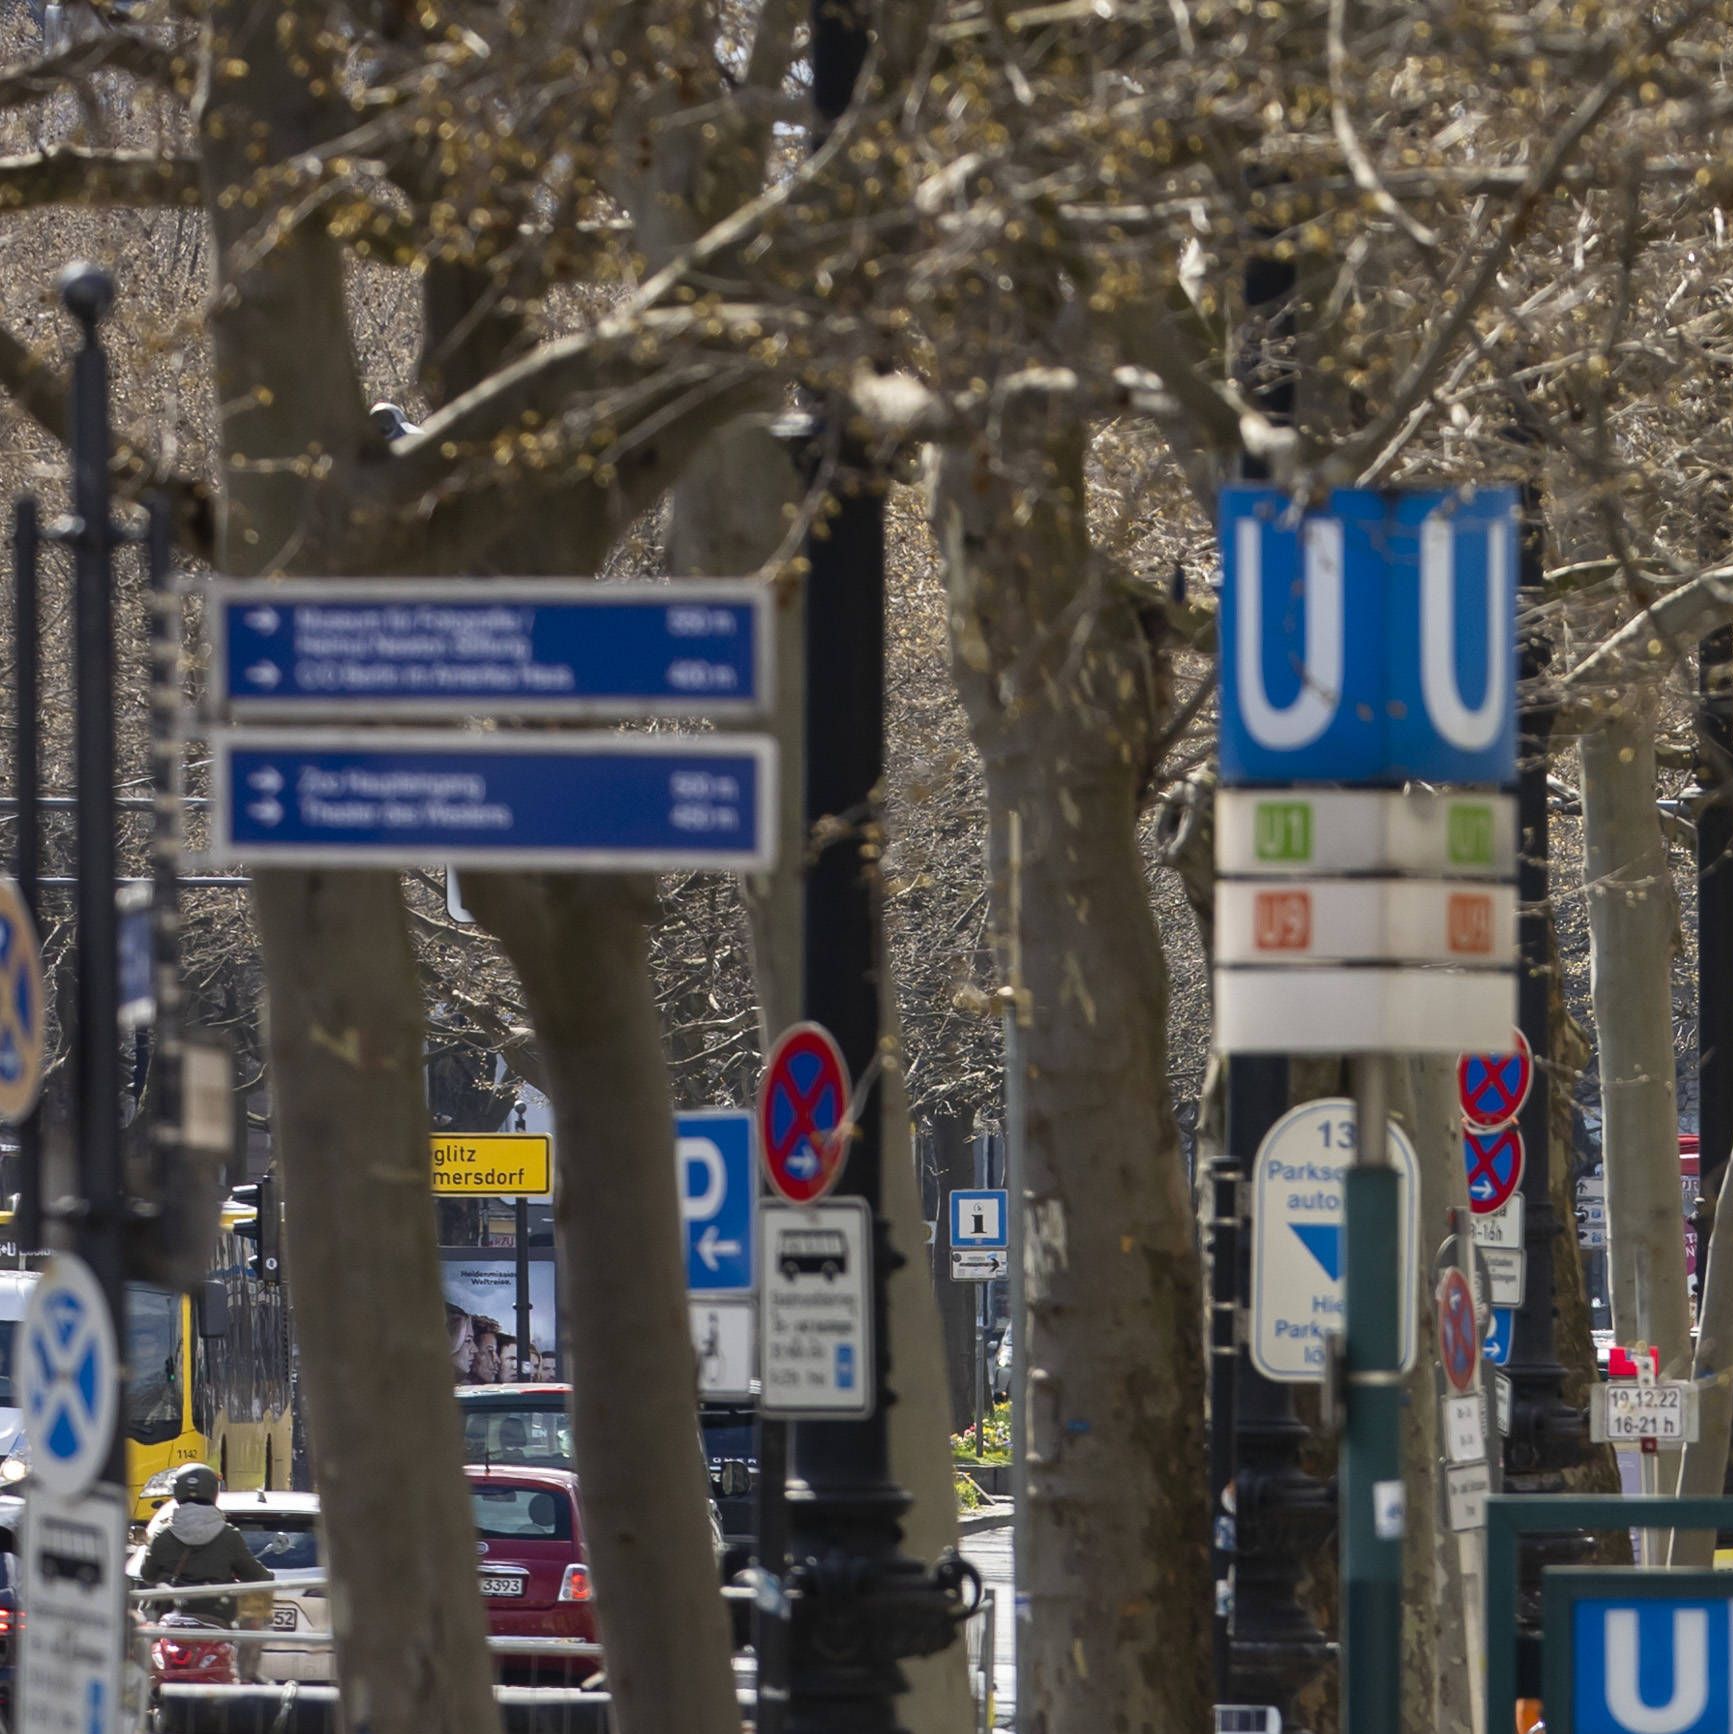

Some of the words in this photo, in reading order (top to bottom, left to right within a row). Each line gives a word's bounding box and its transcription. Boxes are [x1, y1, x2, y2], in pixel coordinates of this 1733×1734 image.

[1236, 518, 1343, 751] U
[1420, 518, 1507, 752] U
[433, 1144, 477, 1167] glitz
[432, 1167, 525, 1186] mersdorf
[1286, 1190, 1340, 1211] auto
[483, 1576, 520, 1593] 3393
